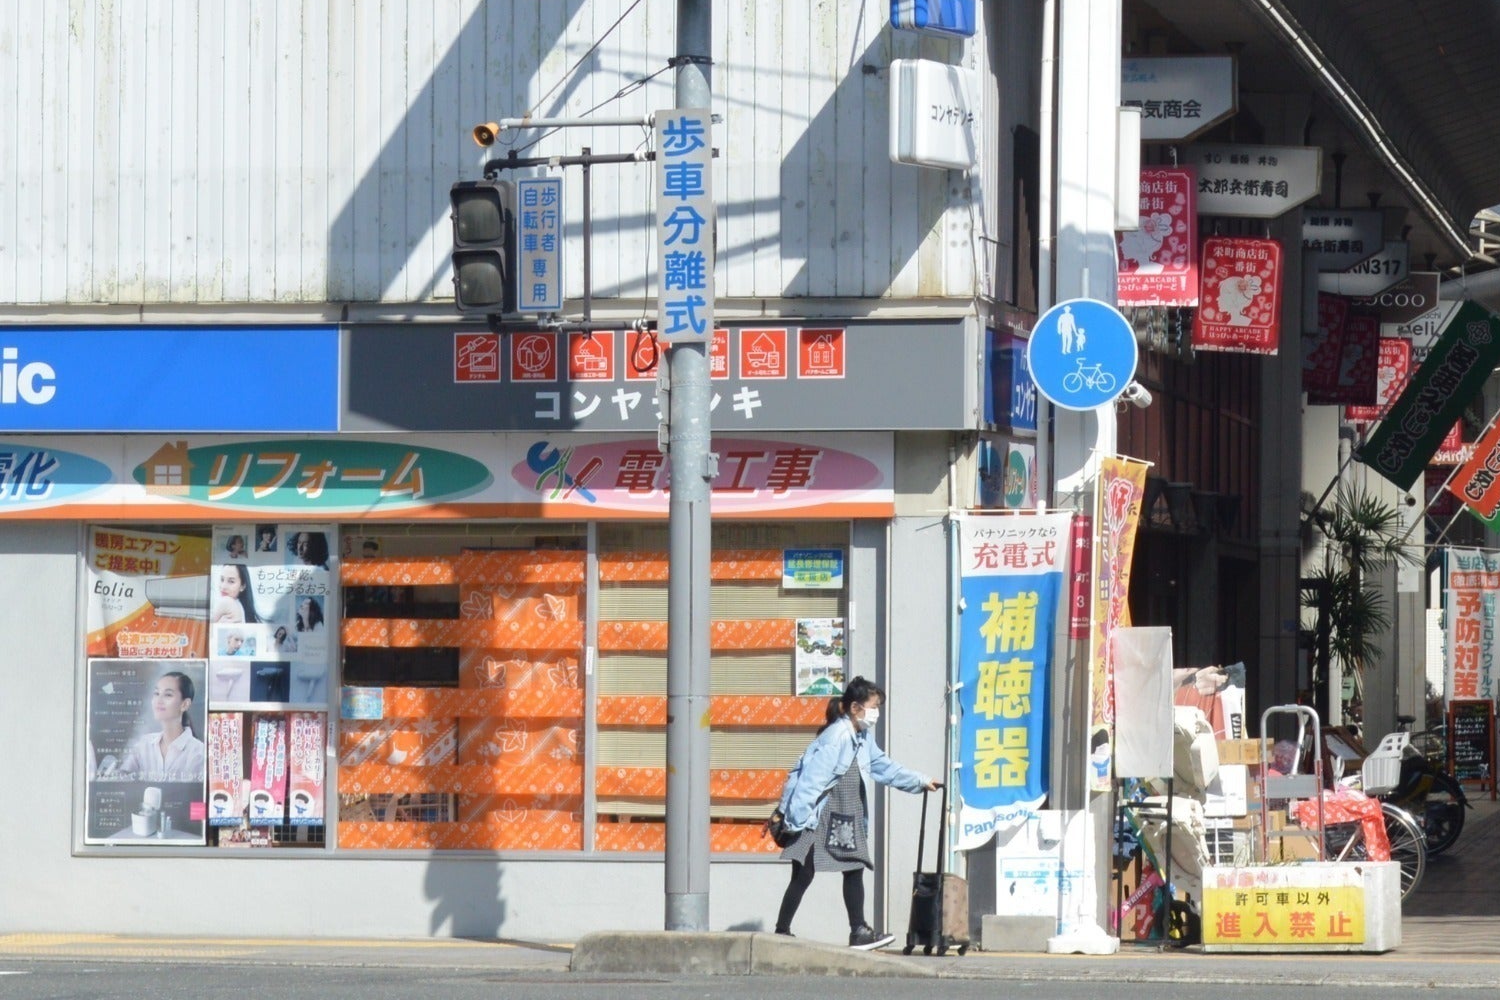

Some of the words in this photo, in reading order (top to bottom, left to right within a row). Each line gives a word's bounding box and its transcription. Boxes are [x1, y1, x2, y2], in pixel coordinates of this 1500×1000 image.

[523, 187, 538, 253] 自転車
[541, 185, 557, 253] 歩行者
[662, 115, 707, 335] 歩車分離式
[1213, 246, 1269, 261] 栄町商店街
[531, 257, 548, 303] 専用
[0, 346, 57, 406] ic
[207, 449, 427, 500] リフォーム
[613, 447, 823, 499] 電工事
[972, 526, 1058, 540] パナソニックなら
[972, 541, 1057, 570] 充電式
[93, 579, 134, 599] Eolia
[1453, 591, 1482, 697] 予防対策
[973, 590, 1039, 790] 補聴器
[1234, 891, 1331, 907] 許可車以外
[1215, 910, 1354, 940] 進入禁止
